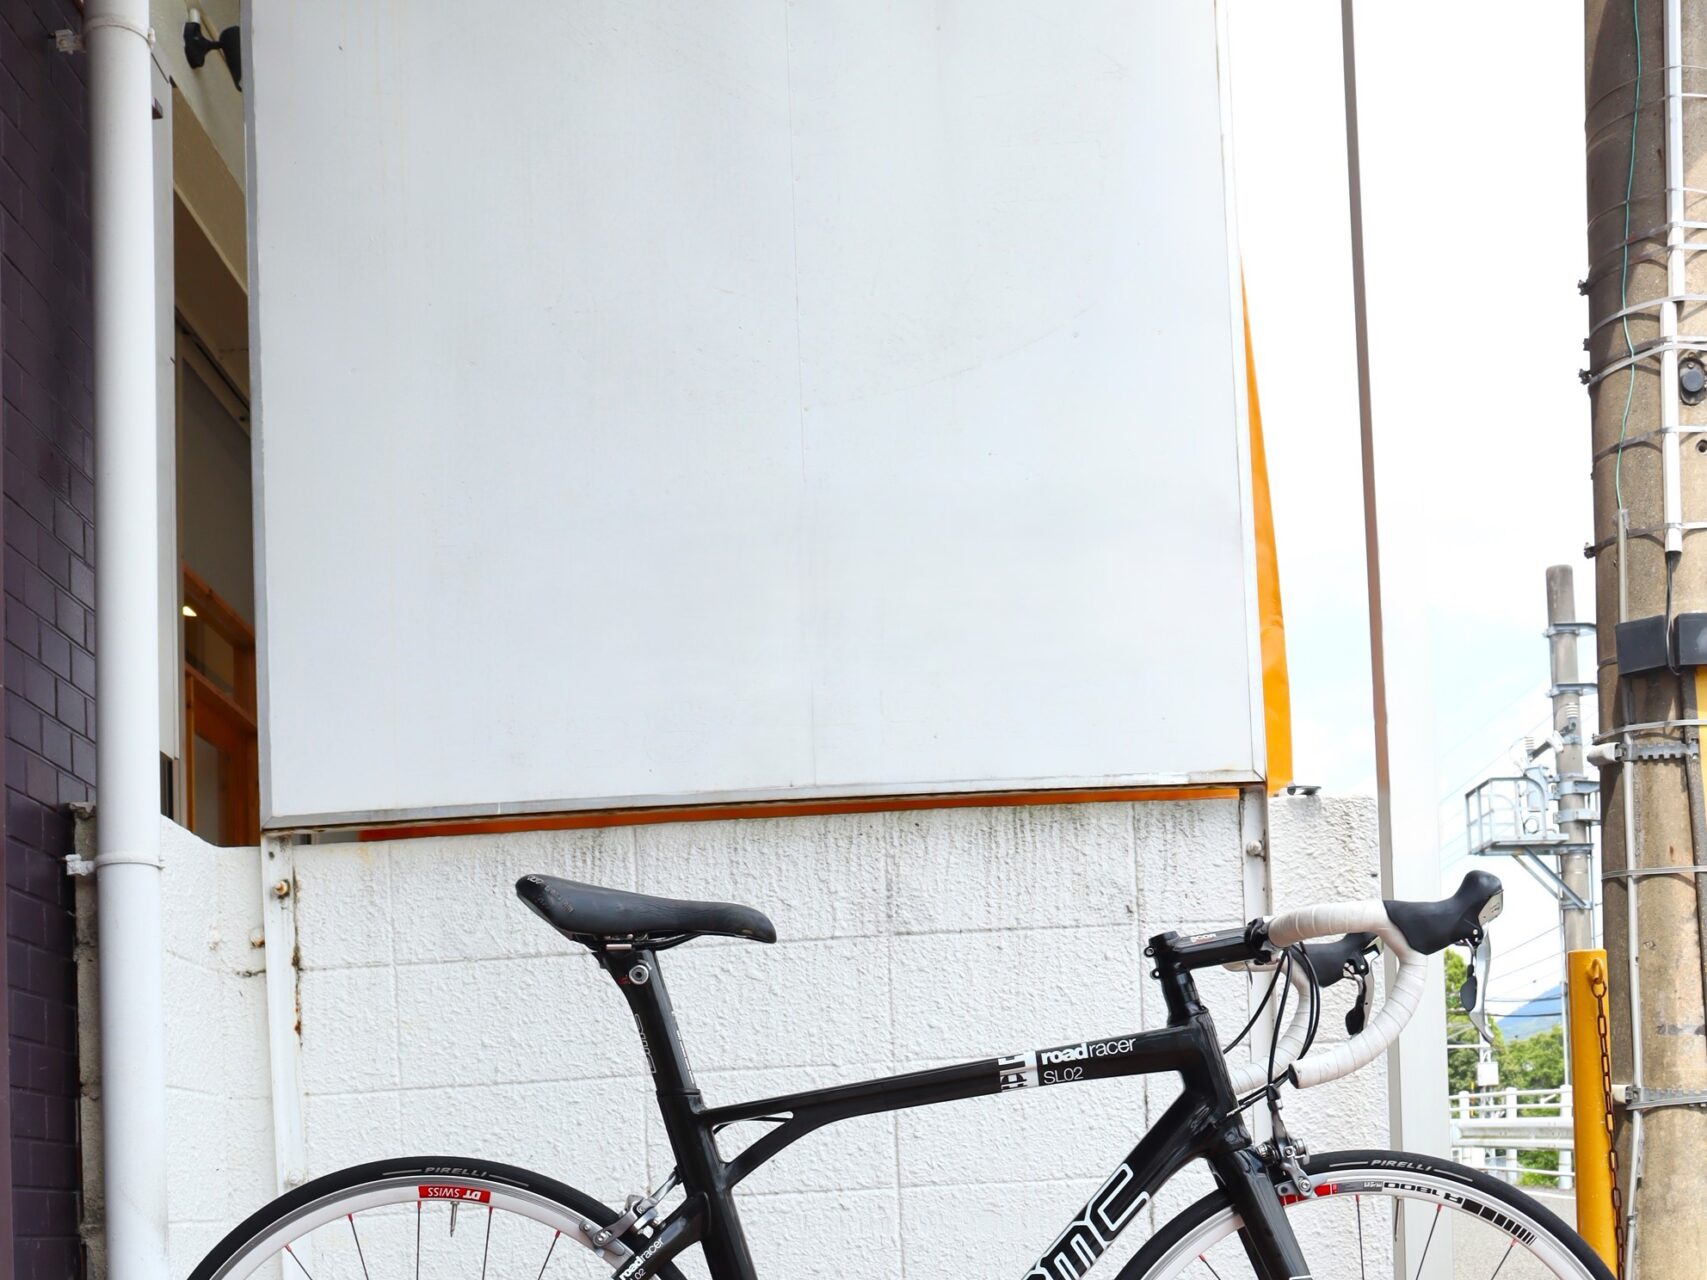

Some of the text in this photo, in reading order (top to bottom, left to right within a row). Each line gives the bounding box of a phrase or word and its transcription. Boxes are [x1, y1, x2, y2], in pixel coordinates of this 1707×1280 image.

[1040, 1038, 1137, 1065] roadracer
[1043, 1066, 1084, 1085] SL02
[424, 1167, 488, 1177] PIRELLI
[1370, 1159, 1432, 1172] PIRELLI
[428, 1187, 481, 1200] DT SWISS
